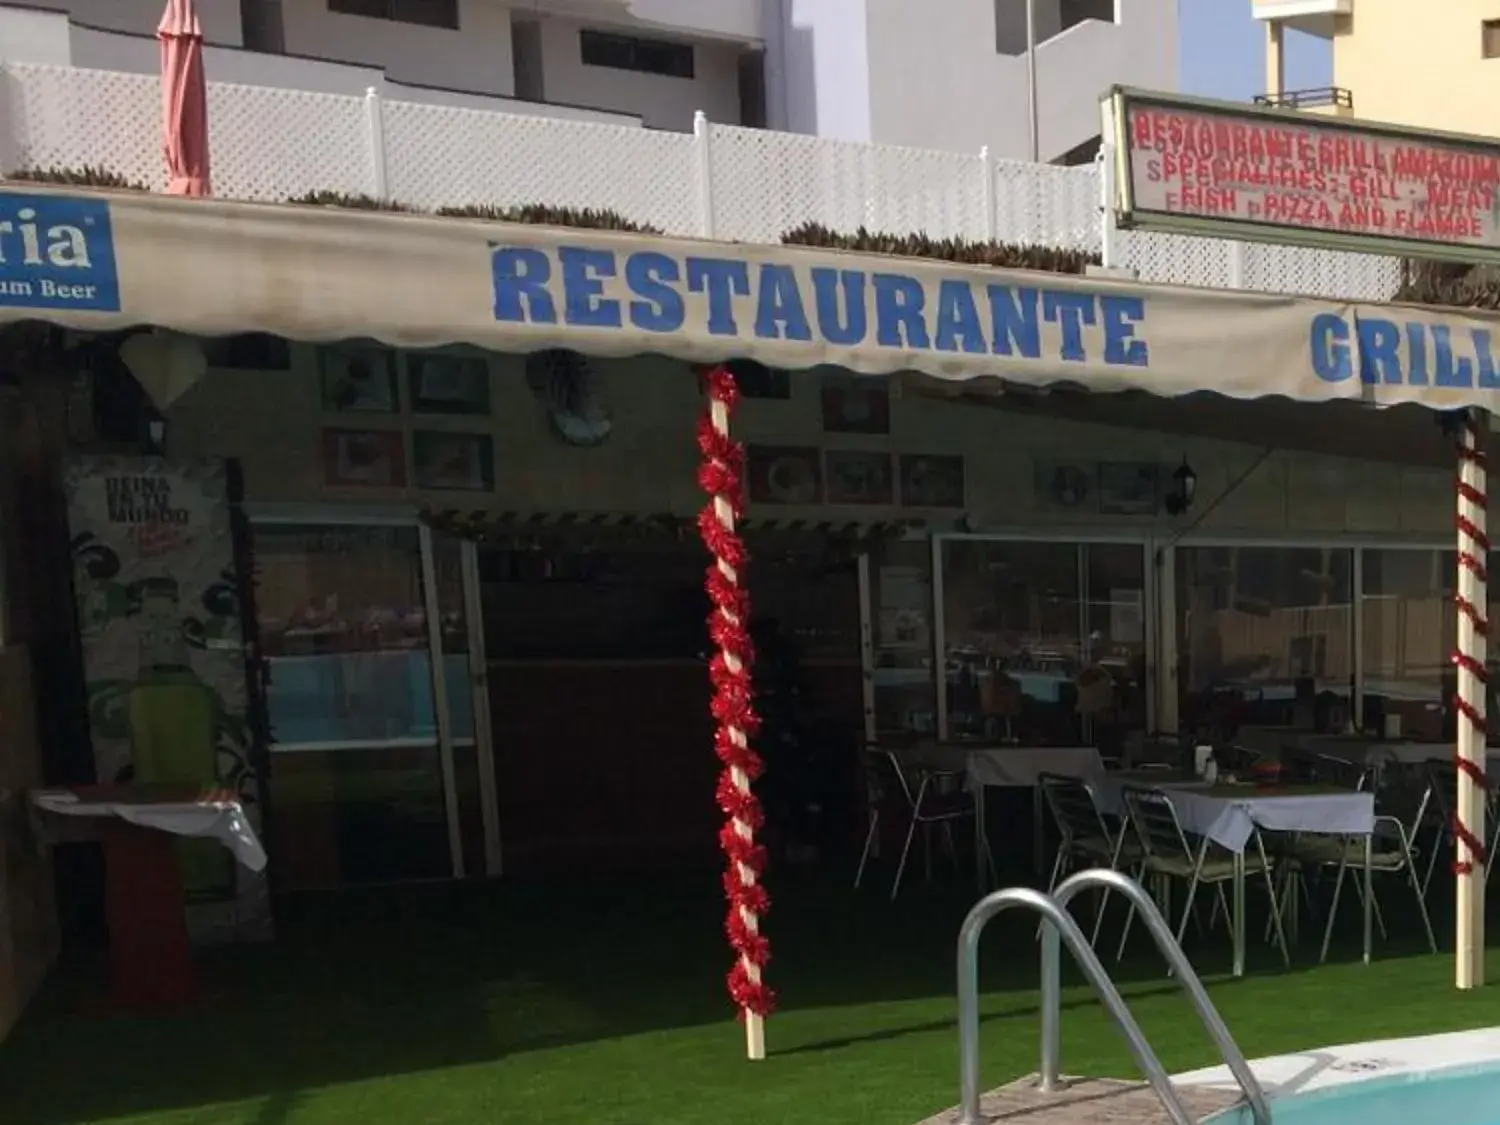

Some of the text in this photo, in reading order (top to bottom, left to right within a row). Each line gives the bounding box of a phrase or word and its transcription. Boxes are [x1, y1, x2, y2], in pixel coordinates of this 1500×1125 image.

[1134, 114, 1311, 160] RESTAURANTE
[1318, 136, 1386, 170] GRILL
[1263, 193, 1330, 227] PIZZA
[1339, 202, 1386, 228] AND
[40, 279, 96, 299] Beer
[493, 246, 1150, 368] RESTAURANTE
